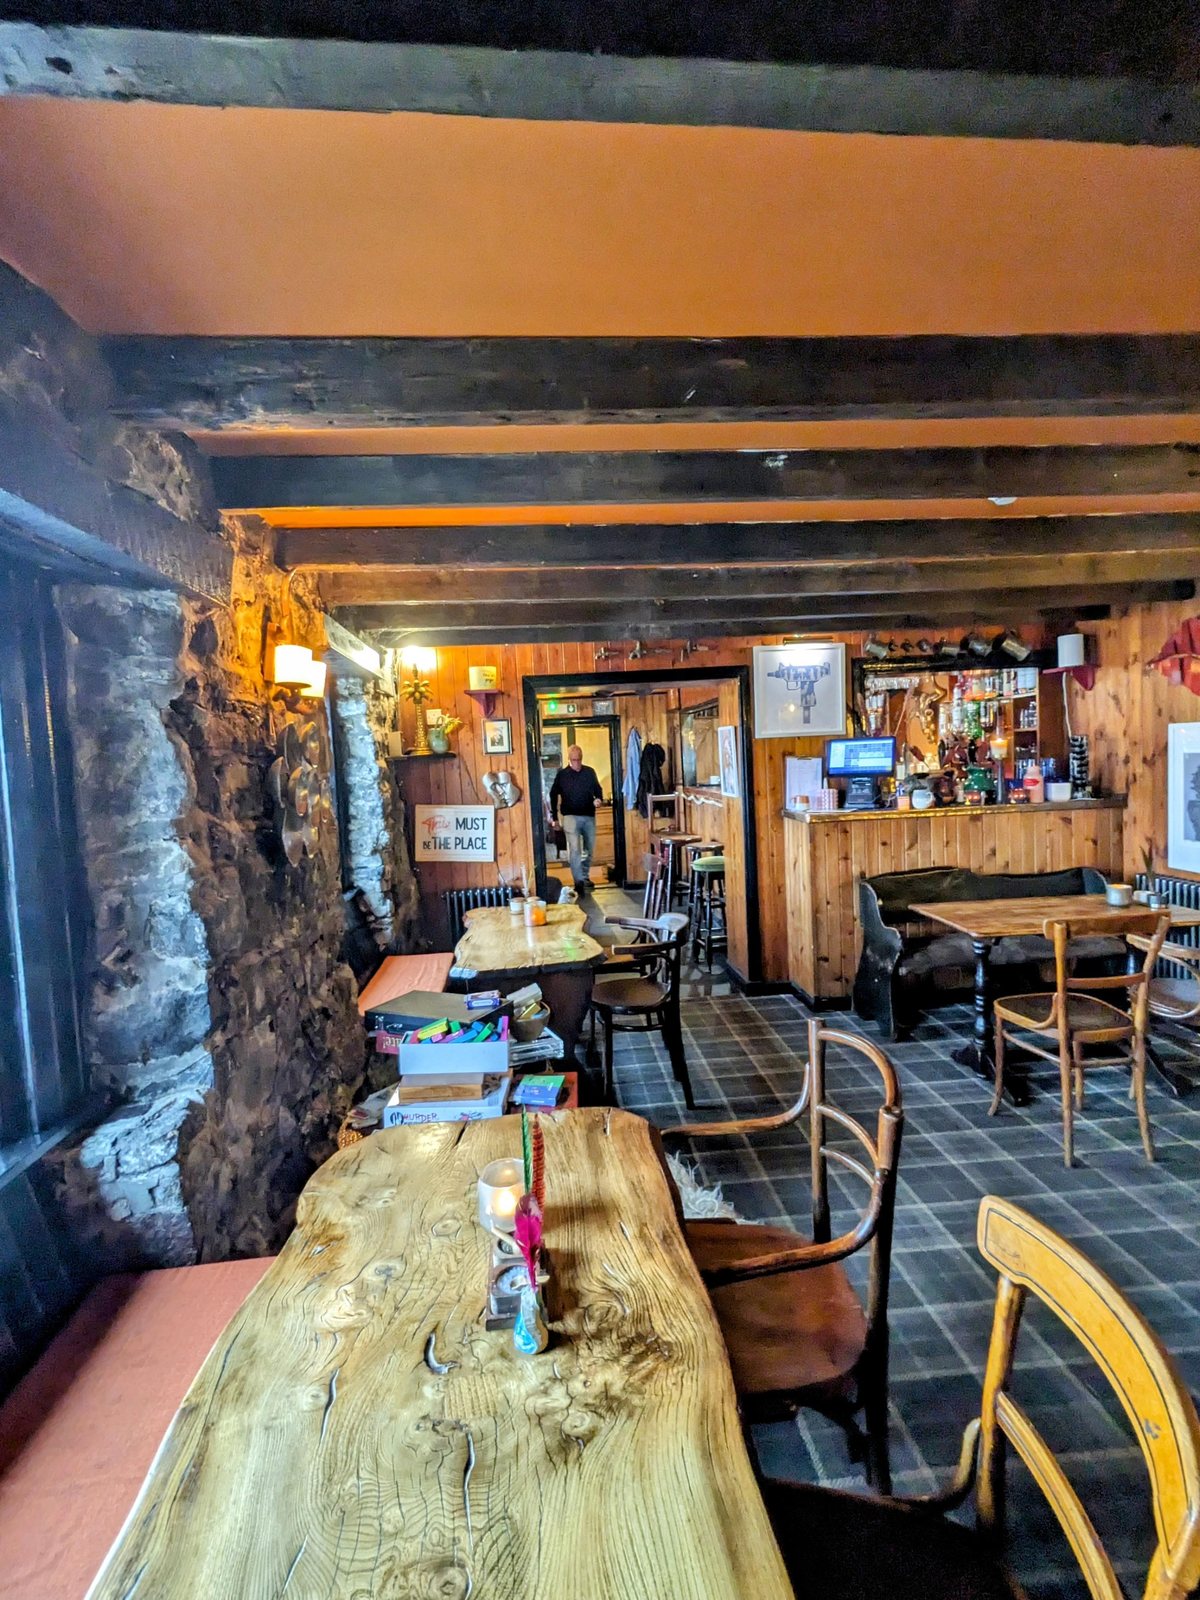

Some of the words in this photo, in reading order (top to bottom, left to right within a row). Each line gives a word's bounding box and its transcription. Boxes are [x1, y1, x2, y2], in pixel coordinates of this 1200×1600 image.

[455, 817, 487, 831] MUST
[432, 836, 451, 850] THE
[454, 836, 487, 850] PLACE
